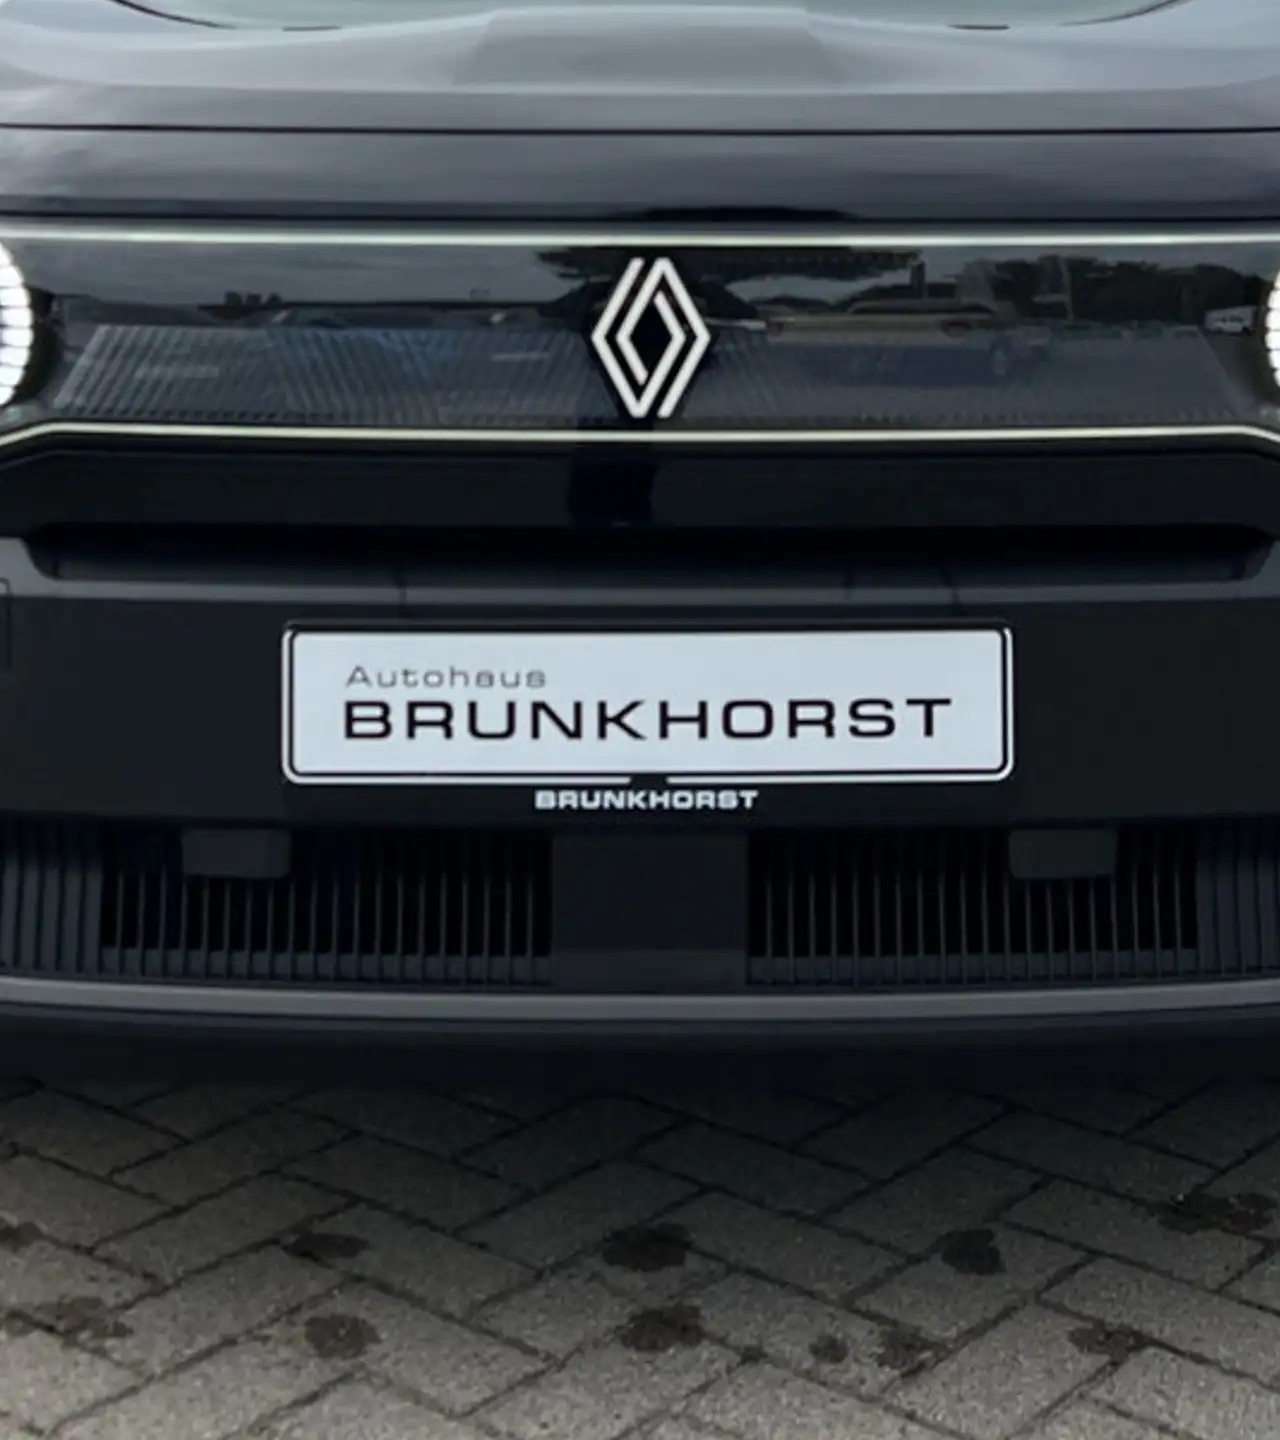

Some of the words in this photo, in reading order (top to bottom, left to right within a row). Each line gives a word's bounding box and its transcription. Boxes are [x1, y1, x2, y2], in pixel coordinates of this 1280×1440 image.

[346, 664, 547, 689] Autohaus
[344, 698, 952, 740] BRUNKHORST
[534, 789, 759, 810] BRUNKHORST
